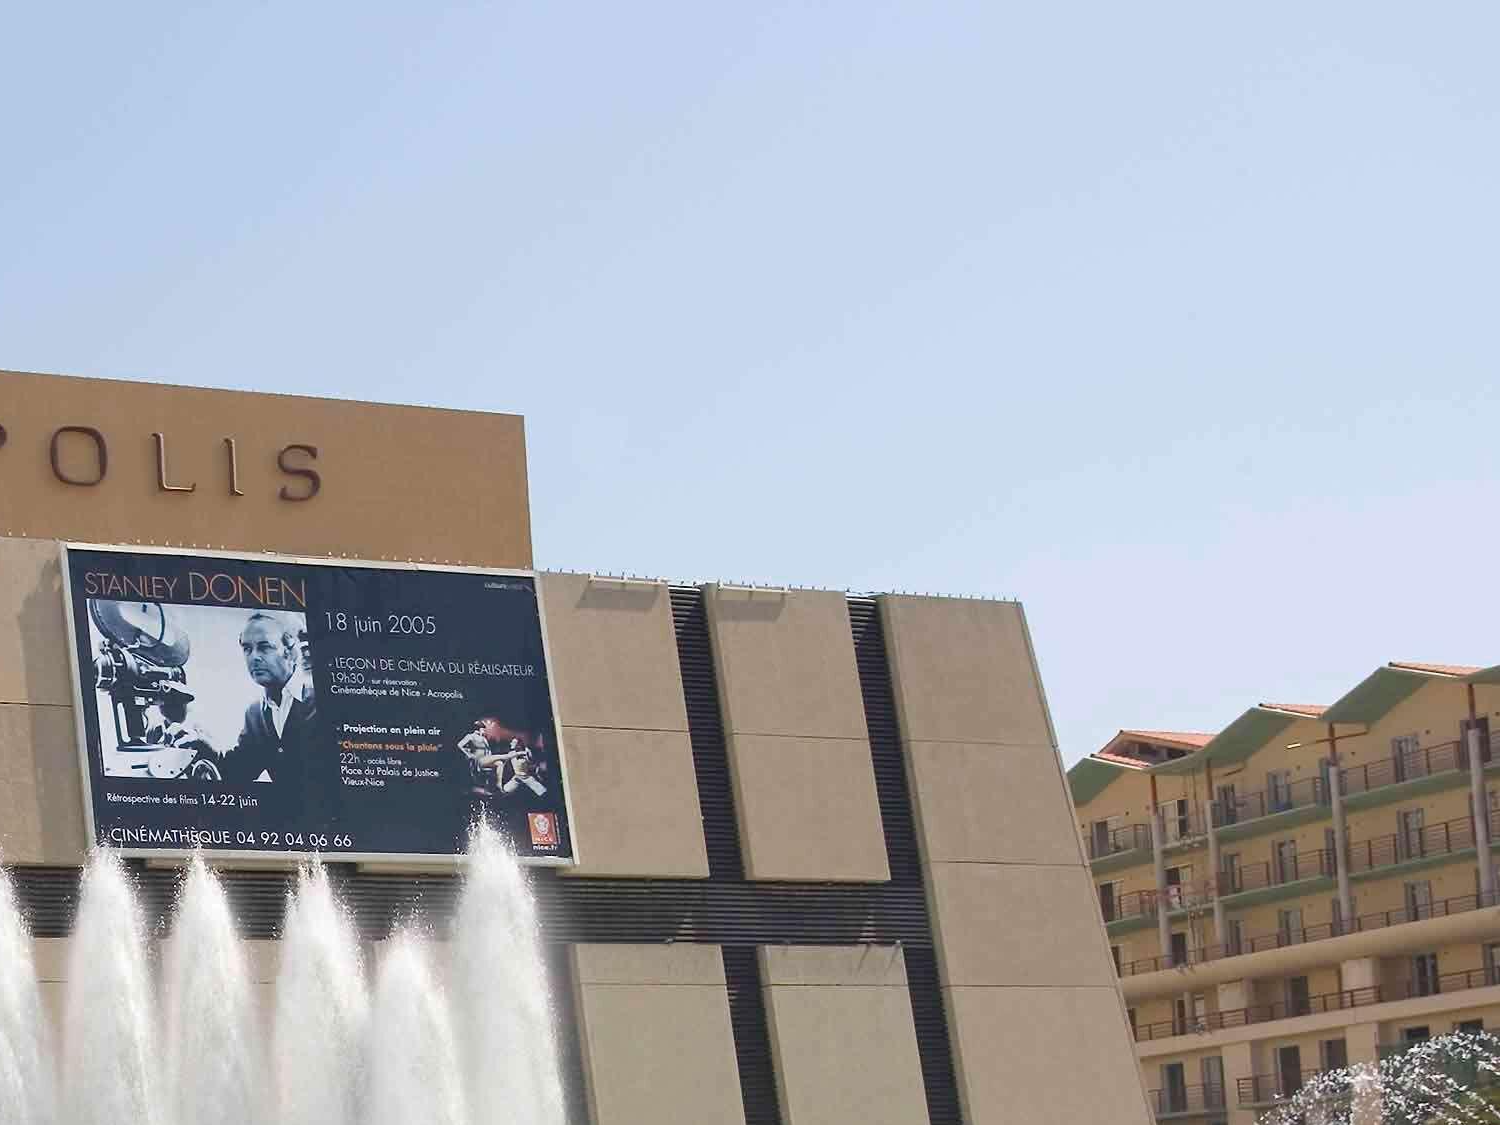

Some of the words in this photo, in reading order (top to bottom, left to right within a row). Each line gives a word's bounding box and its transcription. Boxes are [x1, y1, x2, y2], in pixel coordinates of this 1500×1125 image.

[84, 571, 178, 599] STANLEY
[188, 571, 306, 607] DONEN
[325, 611, 347, 632] 18
[354, 615, 382, 638] juin
[388, 615, 437, 635] 2005
[335, 657, 377, 672] LEÇON
[380, 658, 395, 672] DE
[397, 657, 446, 674] CINÉMA
[449, 662, 465, 675] DU
[468, 659, 534, 677] RÉALISATEUR
[331, 672, 365, 685] 19h30
[330, 684, 388, 697] Cinémathèque
[389, 687, 400, 696] de
[401, 687, 421, 698] Nice
[427, 688, 464, 700] Acropolis
[343, 723, 388, 735] Projection
[389, 727, 402, 735] en
[403, 725, 426, 737] plein
[427, 727, 441, 736] air
[384, 743, 405, 751] sous
[406, 743, 415, 751] la
[339, 752, 360, 765] 22h
[340, 765, 363, 775] Place
[364, 766, 375, 776] du
[376, 766, 400, 777] Palais
[401, 767, 413, 777] de
[414, 767, 440, 778] Justice
[341, 776, 385, 787] Vieux-Nice
[106, 792, 160, 805] Rétrospective
[162, 793, 178, 805] des
[179, 794, 199, 806] films
[200, 793, 236, 807] 14-22
[238, 795, 259, 808] juin
[109, 825, 231, 845] CINÉMATHÈQUE
[236, 830, 256, 845] 04
[260, 831, 280, 847] 92
[284, 832, 304, 847] 04
[308, 833, 328, 848] 06
[333, 833, 353, 848] 66
